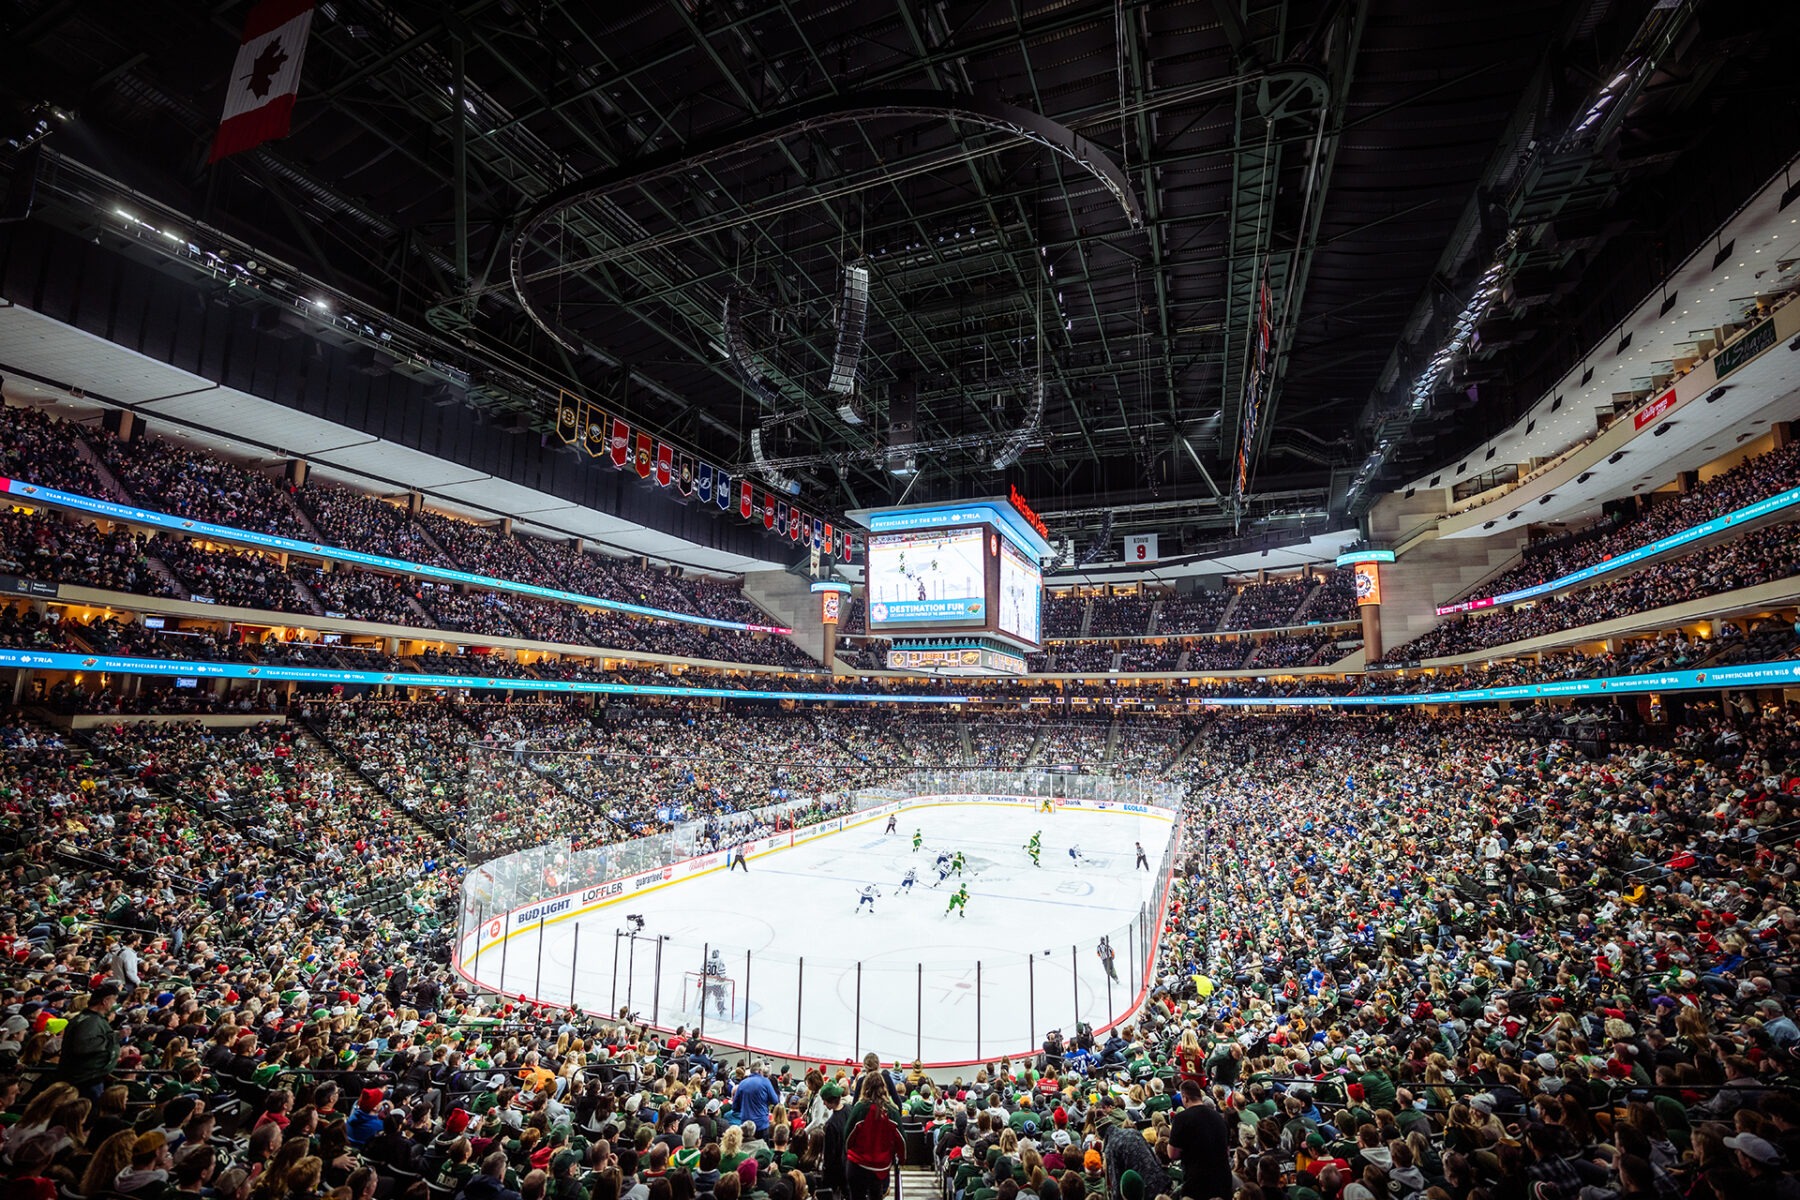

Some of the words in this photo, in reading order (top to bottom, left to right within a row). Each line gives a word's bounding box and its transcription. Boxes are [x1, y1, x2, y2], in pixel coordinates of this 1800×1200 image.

[45, 491, 63, 500] TEAM
[62, 494, 97, 508] PHYSICIANS
[106, 504, 118, 512] THE
[118, 507, 133, 516] WILD
[145, 513, 161, 522] TRIA
[876, 519, 909, 528] PHYSICIANS
[1136, 544, 1147, 560] 9
[889, 603, 946, 613] DESTINATION
[947, 602, 965, 611] FUN
[33, 656, 53, 664] TRIA
[122, 662, 158, 670] PHYSICIANS
[1123, 803, 1148, 813] ECOLAB
[635, 870, 663, 889] guaranteed
[582, 882, 623, 903] LOFFLER
[518, 907, 540, 924] BUD
[540, 898, 571, 916] LIGHT
[706, 964, 717, 976] 30
